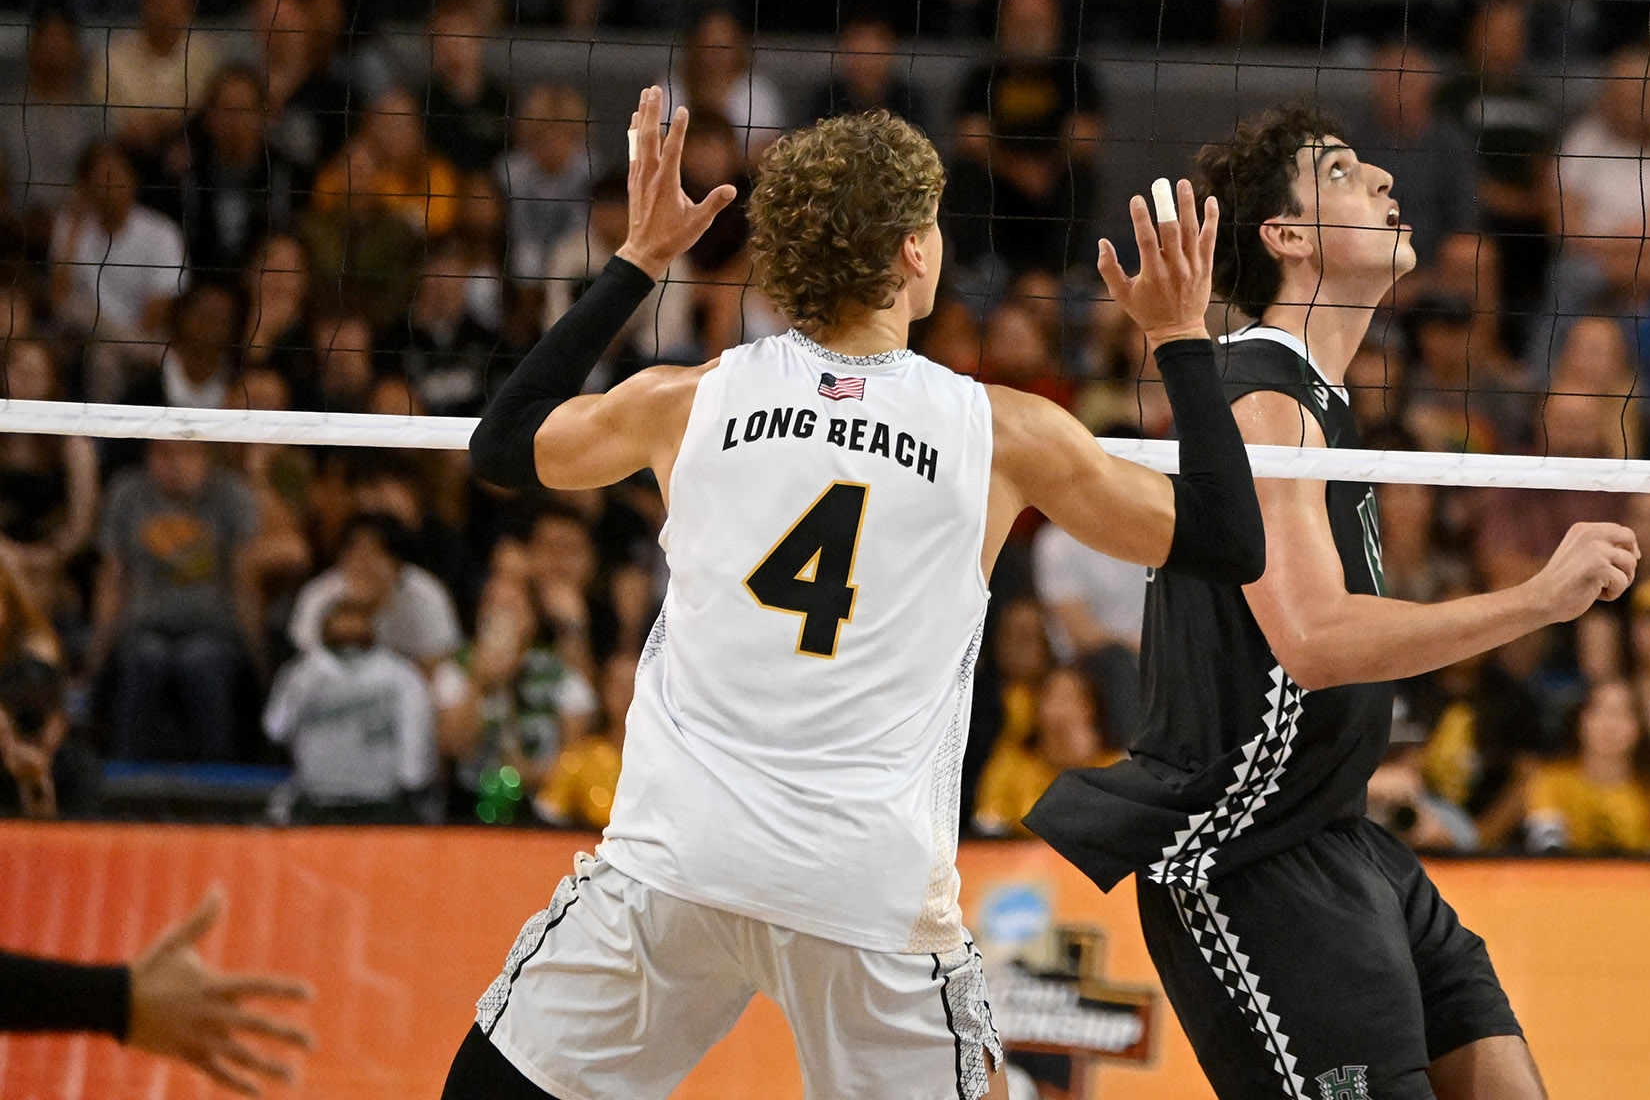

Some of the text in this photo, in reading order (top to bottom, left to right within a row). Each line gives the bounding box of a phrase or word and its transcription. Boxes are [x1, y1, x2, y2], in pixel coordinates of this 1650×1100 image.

[722, 407, 939, 484] LONG BEACH
[740, 479, 870, 660] 4
